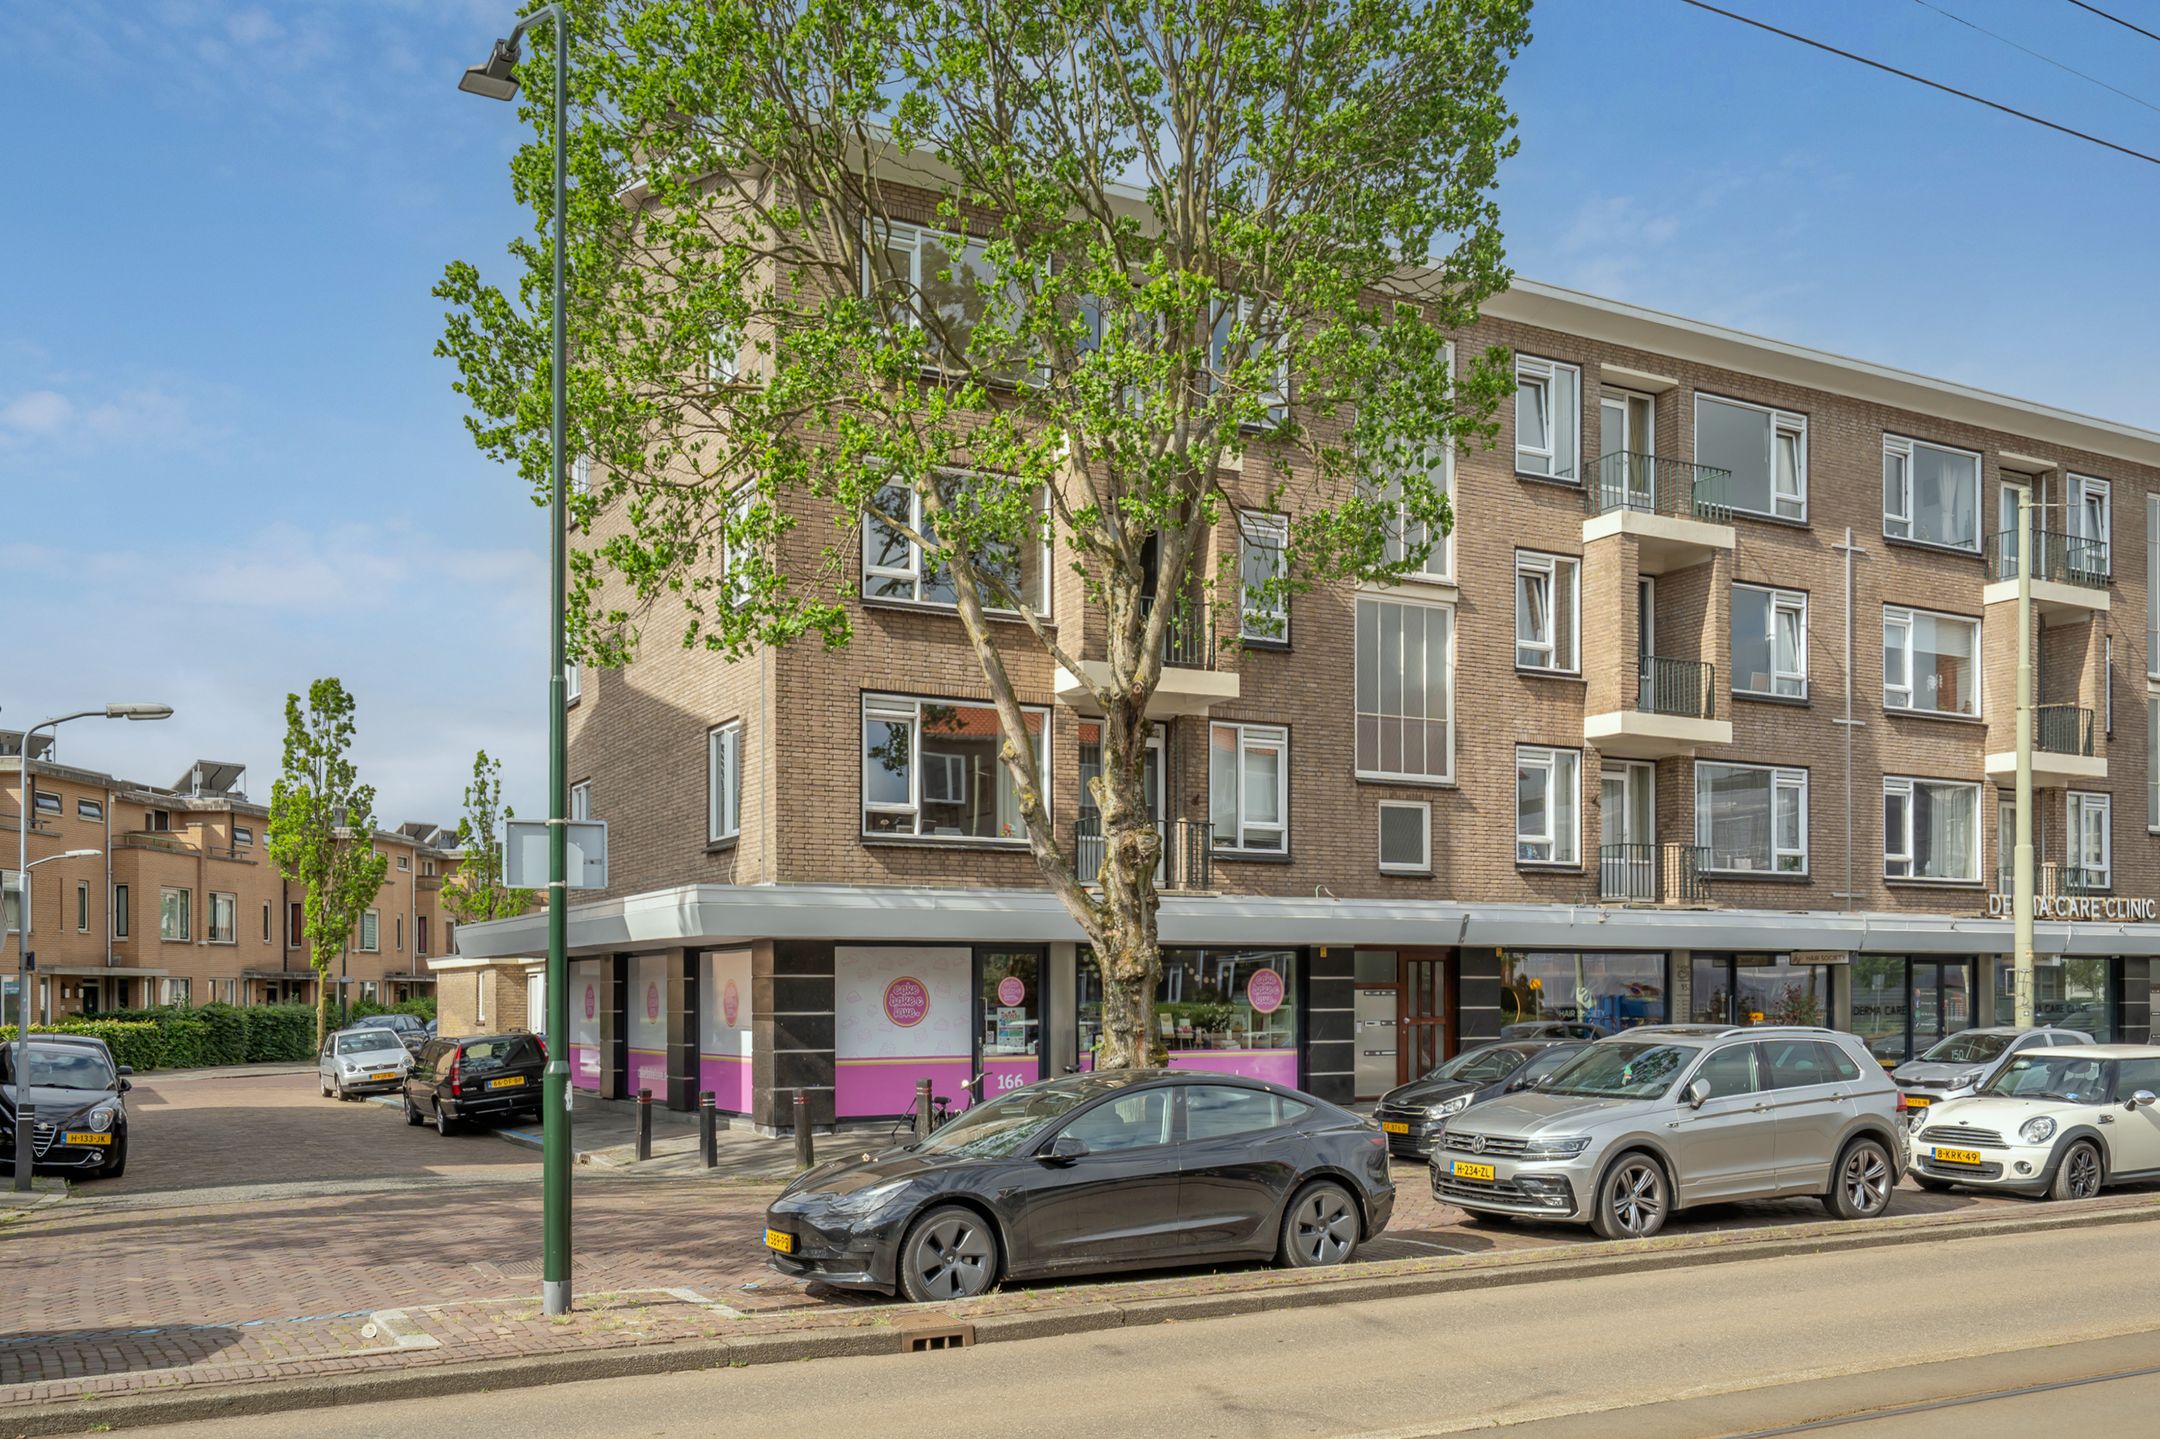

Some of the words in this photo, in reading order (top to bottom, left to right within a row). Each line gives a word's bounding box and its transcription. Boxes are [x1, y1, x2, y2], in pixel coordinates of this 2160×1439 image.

[2055, 896, 2100, 917] CARE
[2105, 898, 2156, 919] CLINIC
[893, 982, 920, 995] cake
[888, 994, 915, 1007] bake
[1559, 1009, 1576, 1017] HAIR
[1884, 1005, 1907, 1016] CARE
[997, 1073, 1024, 1089] 166
[70, 1135, 106, 1144] H-133-JK
[1937, 1149, 1978, 1161] 8-KRK-49
[1457, 1164, 1490, 1178] H-234-ZL
